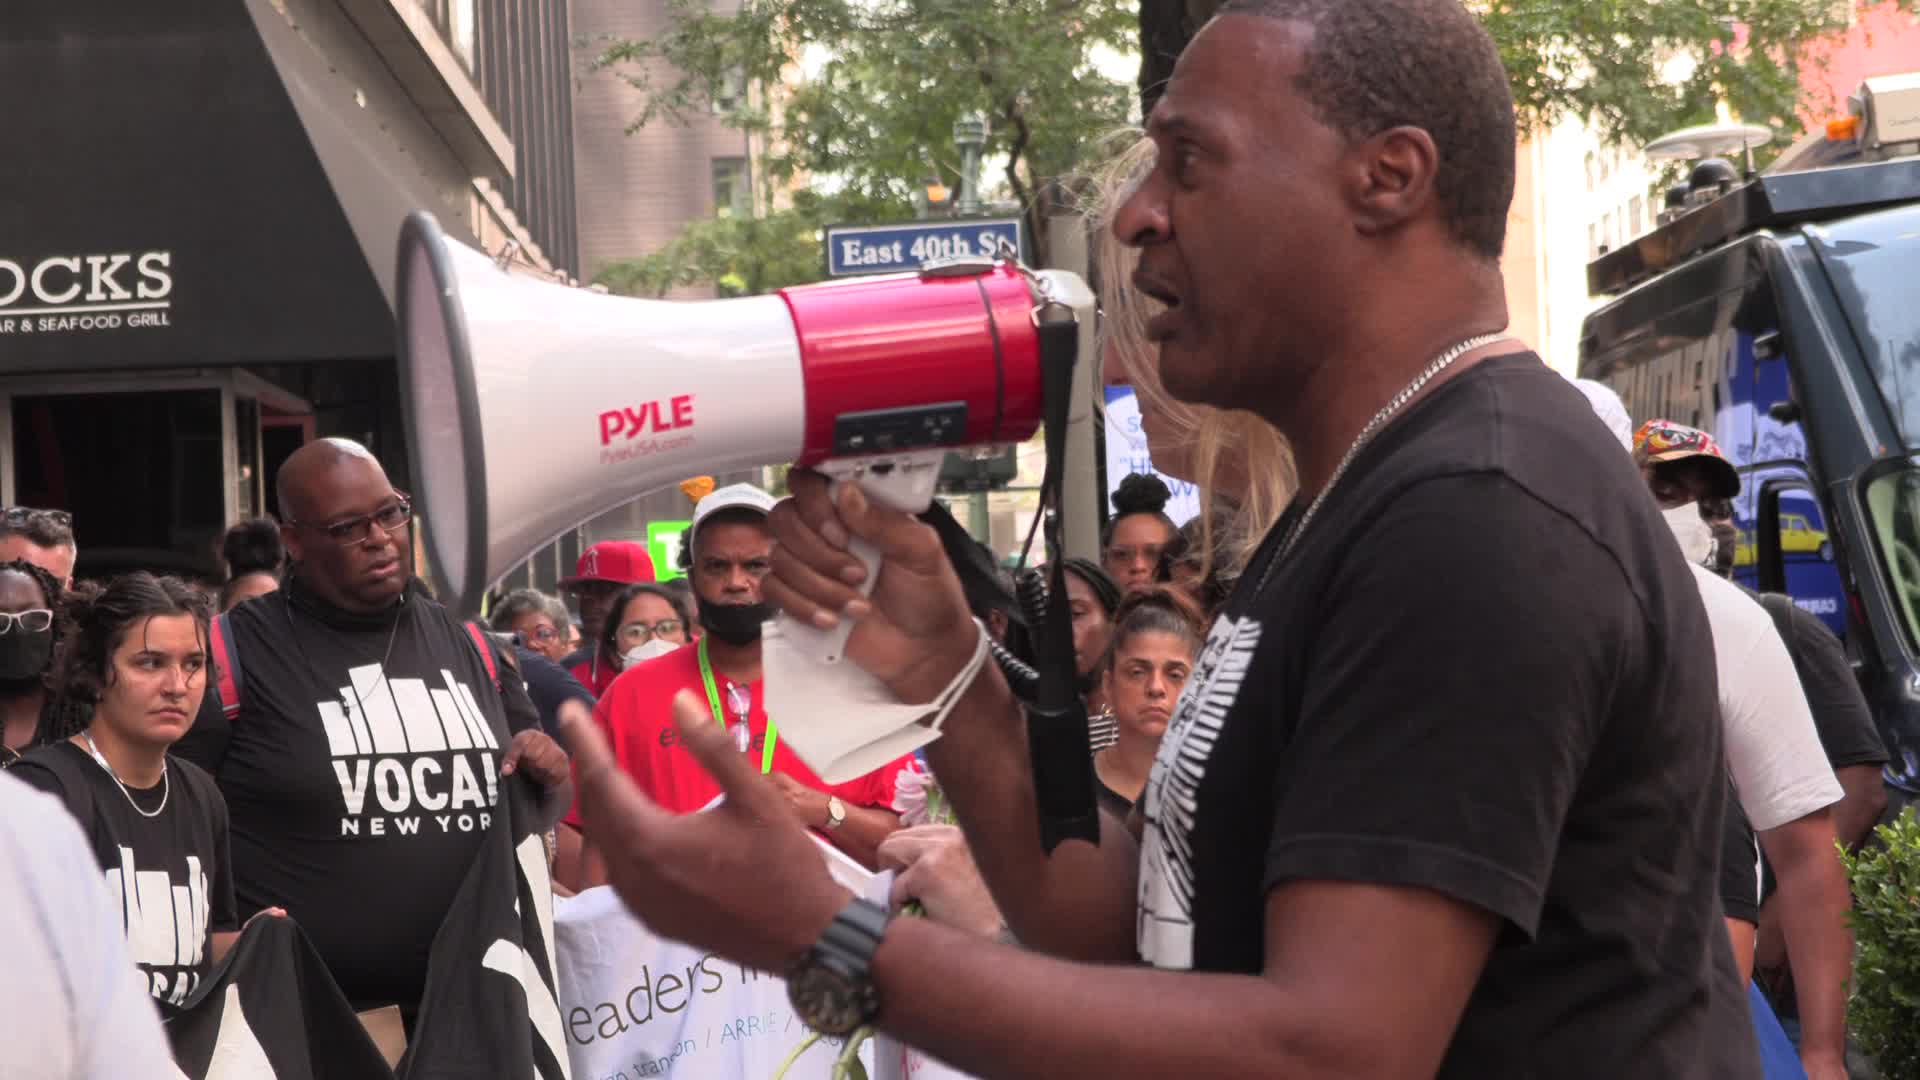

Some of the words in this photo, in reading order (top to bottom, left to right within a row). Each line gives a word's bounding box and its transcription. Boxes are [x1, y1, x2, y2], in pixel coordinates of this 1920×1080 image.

[841, 240, 904, 266] East
[909, 233, 971, 262] 40th
[20, 319, 33, 333] &
[38, 314, 121, 332] SEAFOOD
[127, 311, 170, 328] GRILL
[599, 395, 694, 446] PYLE
[341, 817, 420, 836] NEW
[435, 812, 492, 833] YOR
